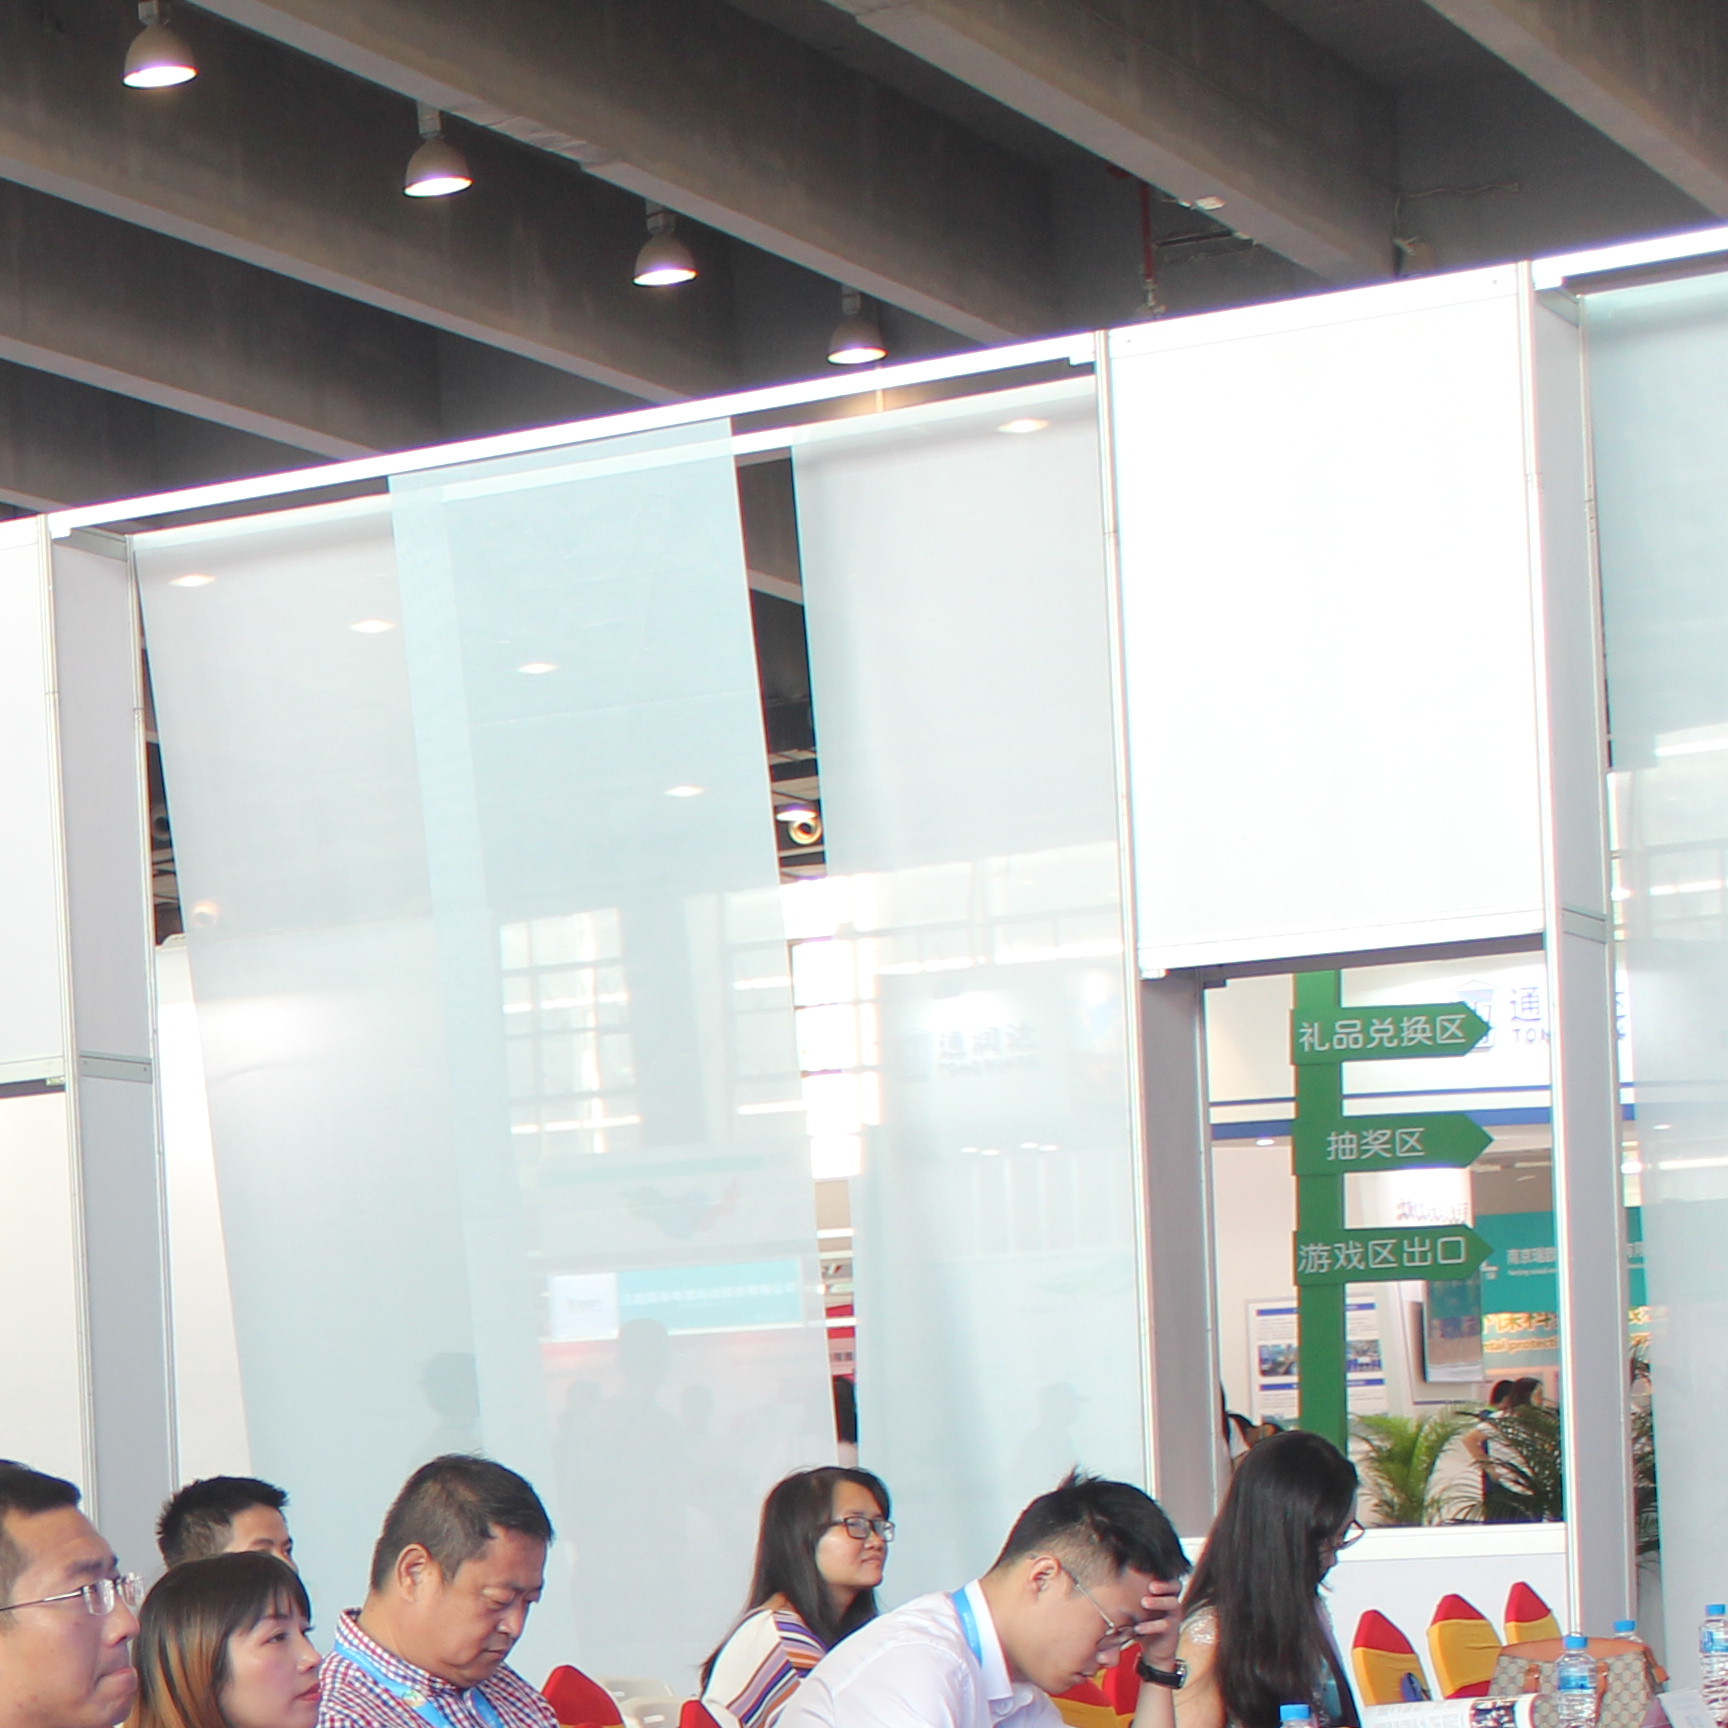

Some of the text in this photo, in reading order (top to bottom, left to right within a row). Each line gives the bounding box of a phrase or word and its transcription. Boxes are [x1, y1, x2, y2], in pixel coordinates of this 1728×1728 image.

[1298, 1014, 1466, 1053] 礼品兑换区
[1325, 1127, 1425, 1162] 抽奖区
[1297, 1236, 1466, 1275] 游戏区出口
